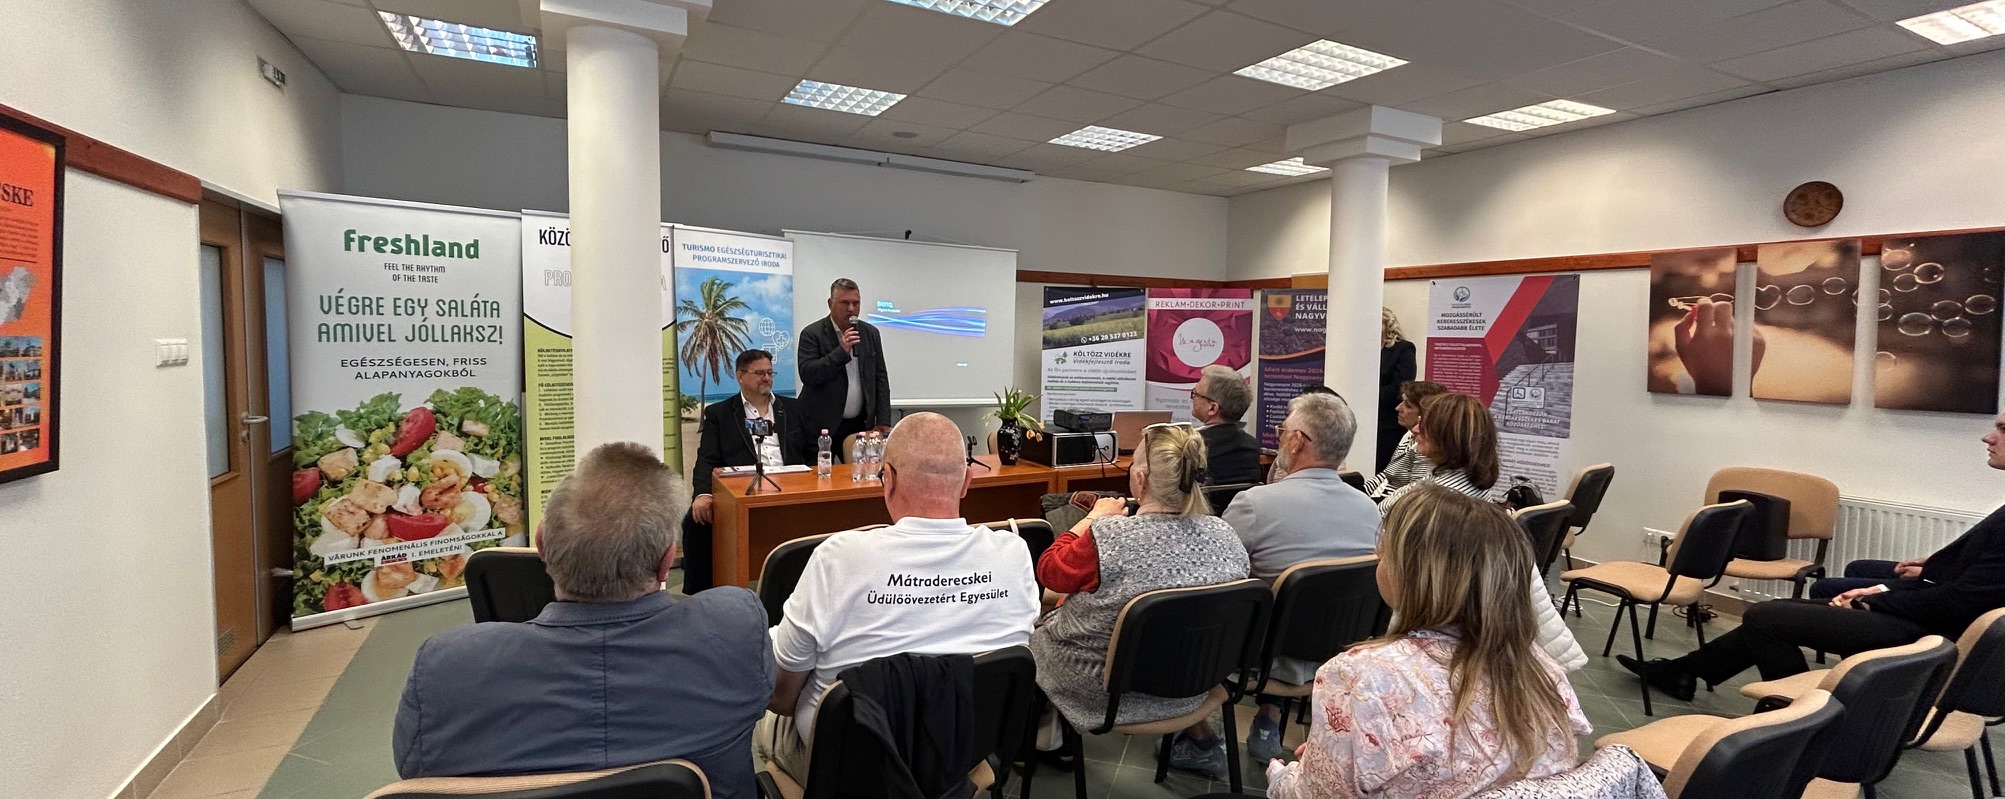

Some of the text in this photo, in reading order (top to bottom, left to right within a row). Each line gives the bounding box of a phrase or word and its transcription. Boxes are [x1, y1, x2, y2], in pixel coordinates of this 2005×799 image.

[0, 182, 34, 207] SKE
[343, 229, 480, 260] freshland
[682, 243, 787, 260] TURISMO EGÉSZSÉGTURISZTIKAI
[384, 262, 446, 274] FEEL THE RHYTHM
[692, 254, 780, 268] PROGRAMSZERVEZŐ IRODA
[392, 274, 439, 284] OF THE TASTE
[319, 288, 500, 319] VÉGRE EGY SALÁTA
[1295, 302, 1305, 310] ÉS
[317, 316, 504, 345] AMIVEL JÓLLAKSZ!
[340, 356, 487, 368] EGÉSZSÉGESEN, FRISS
[1104, 350, 1131, 358] VIDÉKRE
[354, 368, 476, 380] ALAPANYAGOKBÓL
[328, 550, 366, 562] VÁRUNK
[368, 541, 428, 556] FENOMENÁLIS
[430, 532, 496, 547] FINOMSÁGOKKAL
[887, 571, 992, 587] Mátraderecskei
[867, 589, 1009, 605] Üdülőövezetért Egyesület
